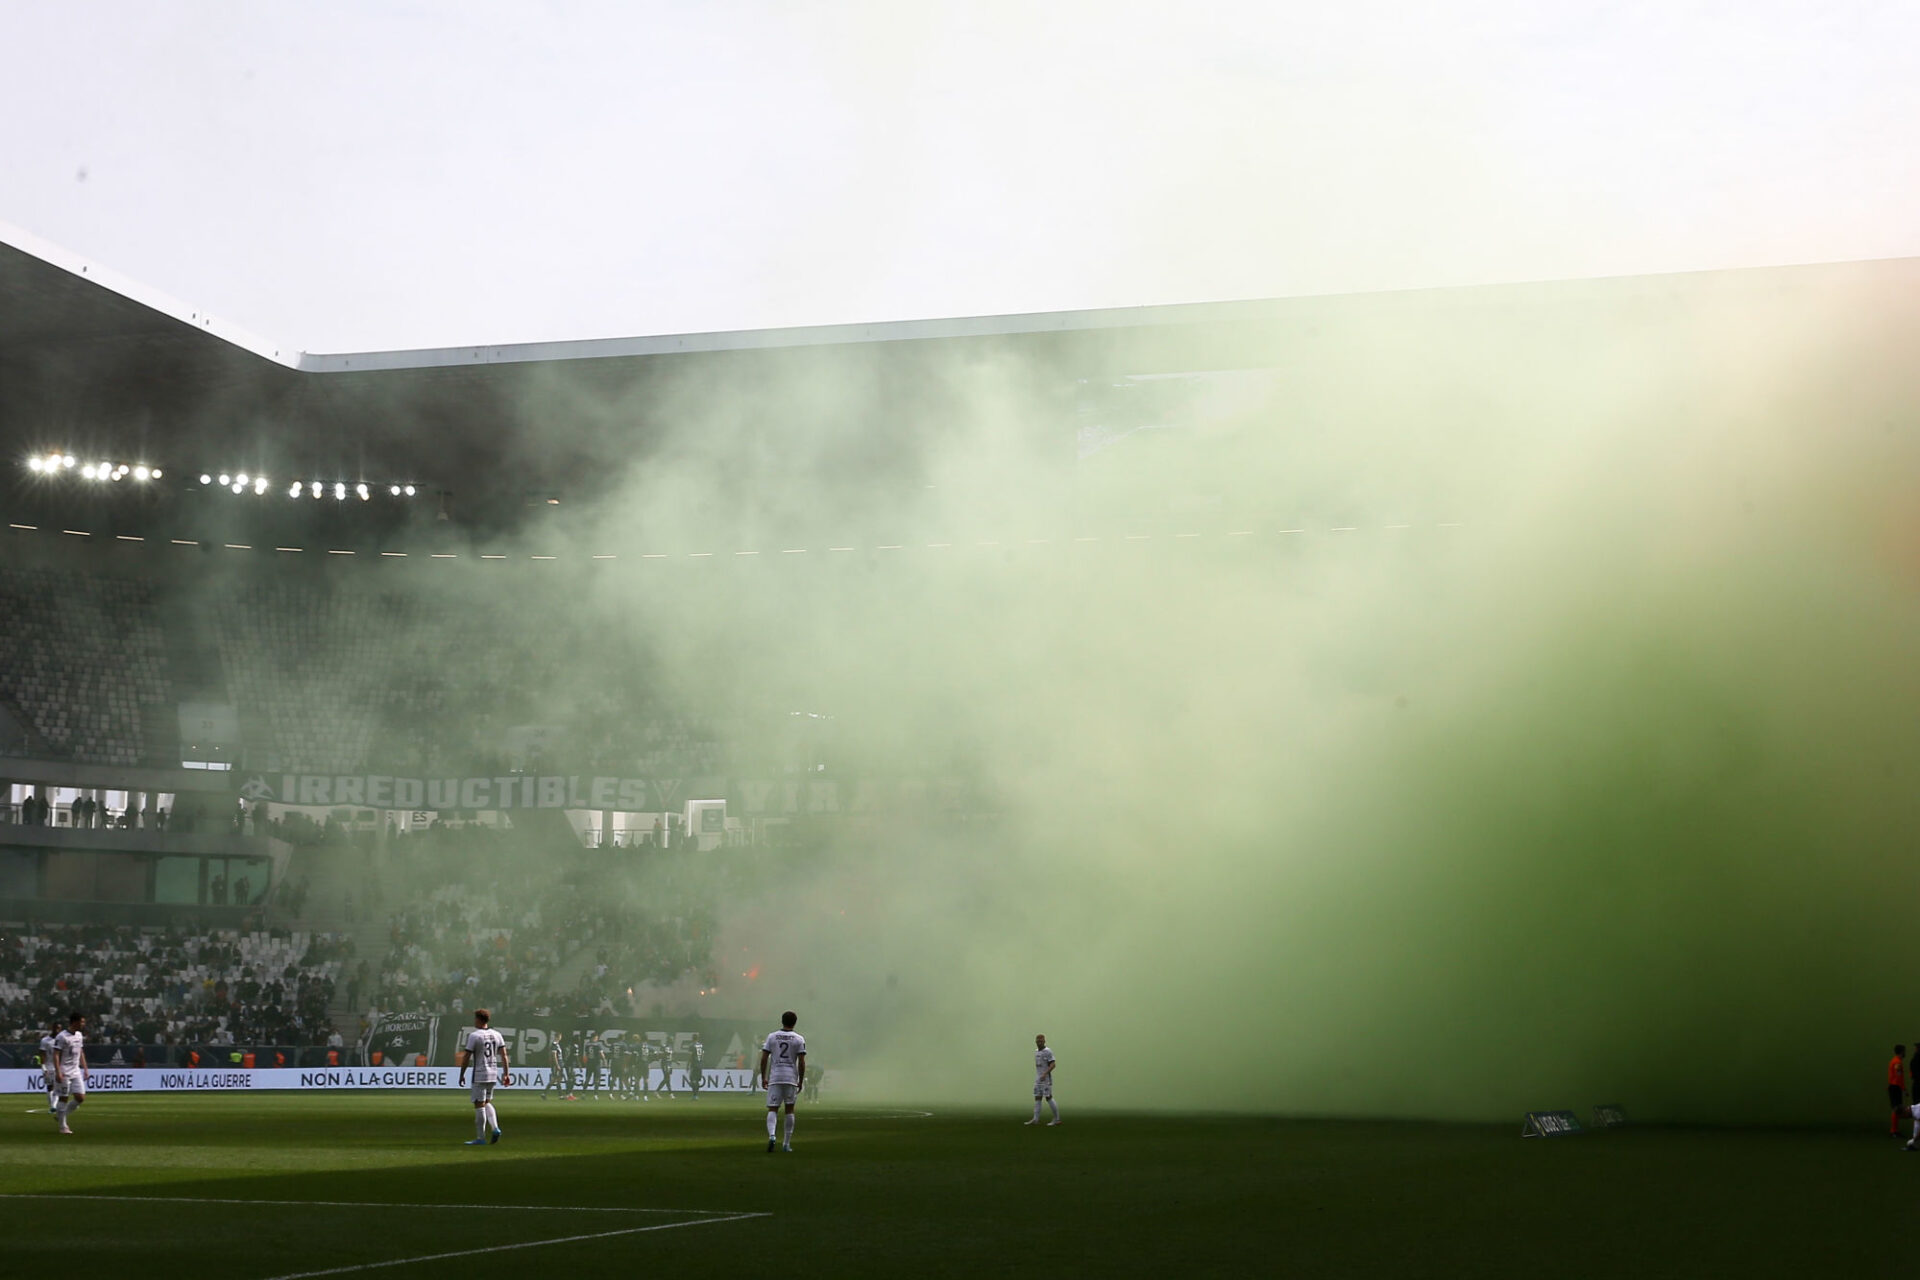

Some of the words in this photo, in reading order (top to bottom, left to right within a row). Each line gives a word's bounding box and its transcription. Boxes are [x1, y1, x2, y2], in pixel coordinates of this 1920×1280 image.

[282, 774, 647, 809] IRREDUCTIBLES
[484, 1041, 496, 1058] 31
[779, 1042, 790, 1058] 2
[27, 1074, 46, 1090] NO
[87, 1074, 133, 1089] GUERRE
[160, 1073, 184, 1089] NON
[186, 1070, 195, 1088] À
[196, 1073, 210, 1088] LA
[211, 1073, 251, 1088] GUERRE
[301, 1073, 340, 1087] NON
[345, 1069, 355, 1086] À
[359, 1072, 379, 1086] LA
[383, 1072, 447, 1086] GUERRE
[533, 1070, 545, 1087] À
[723, 1071, 735, 1089] À
